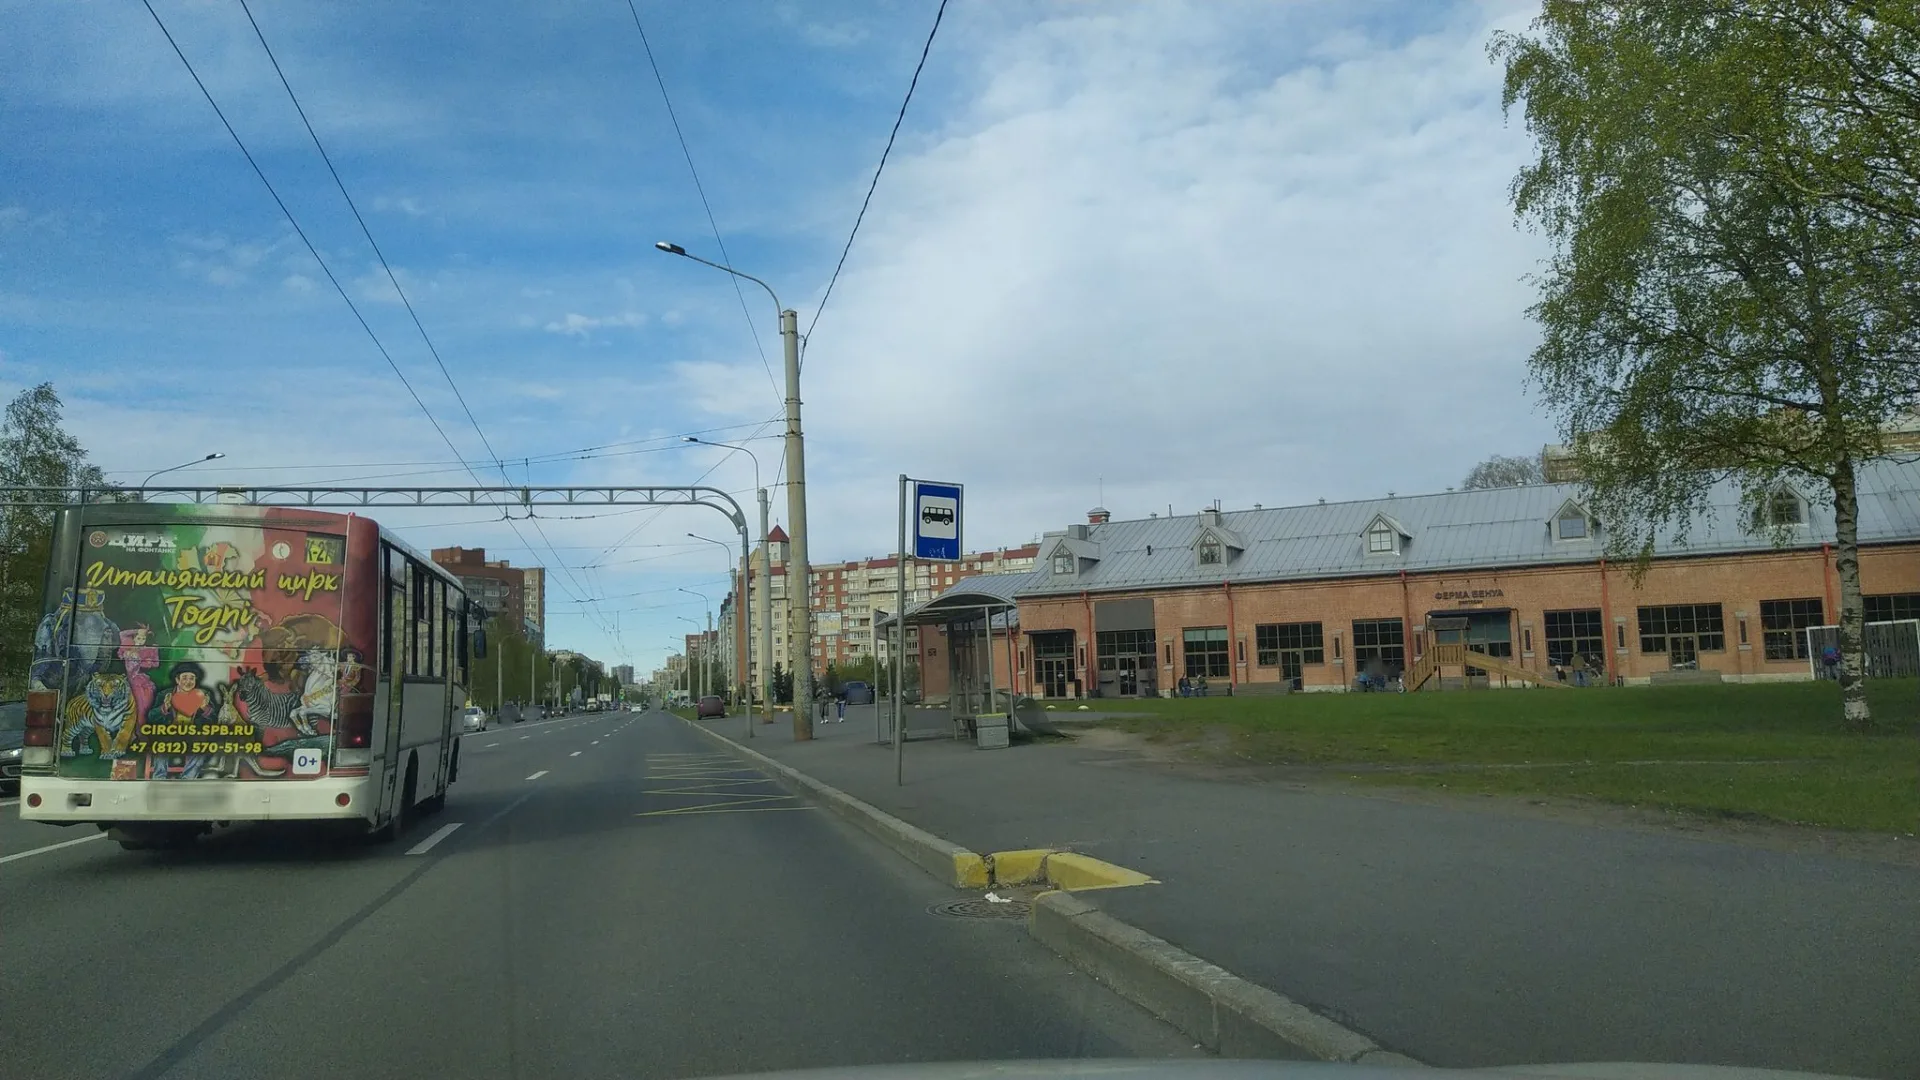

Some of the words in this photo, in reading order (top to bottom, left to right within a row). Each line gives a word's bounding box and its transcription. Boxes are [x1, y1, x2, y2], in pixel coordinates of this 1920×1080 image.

[108, 534, 177, 548] ЦИРК
[86, 561, 267, 590] Итальянский
[277, 569, 339, 601] цирк
[1435, 590, 1470, 600] ФЕРМА
[1471, 588, 1505, 599] БЕНУА
[165, 595, 256, 644] Togni
[140, 724, 255, 736] CIRCUS.SPB.RU
[130, 743, 147, 753] +7
[151, 742, 187, 754] (812)
[191, 742, 262, 754] 570-51-98
[297, 756, 318, 768] 0+
